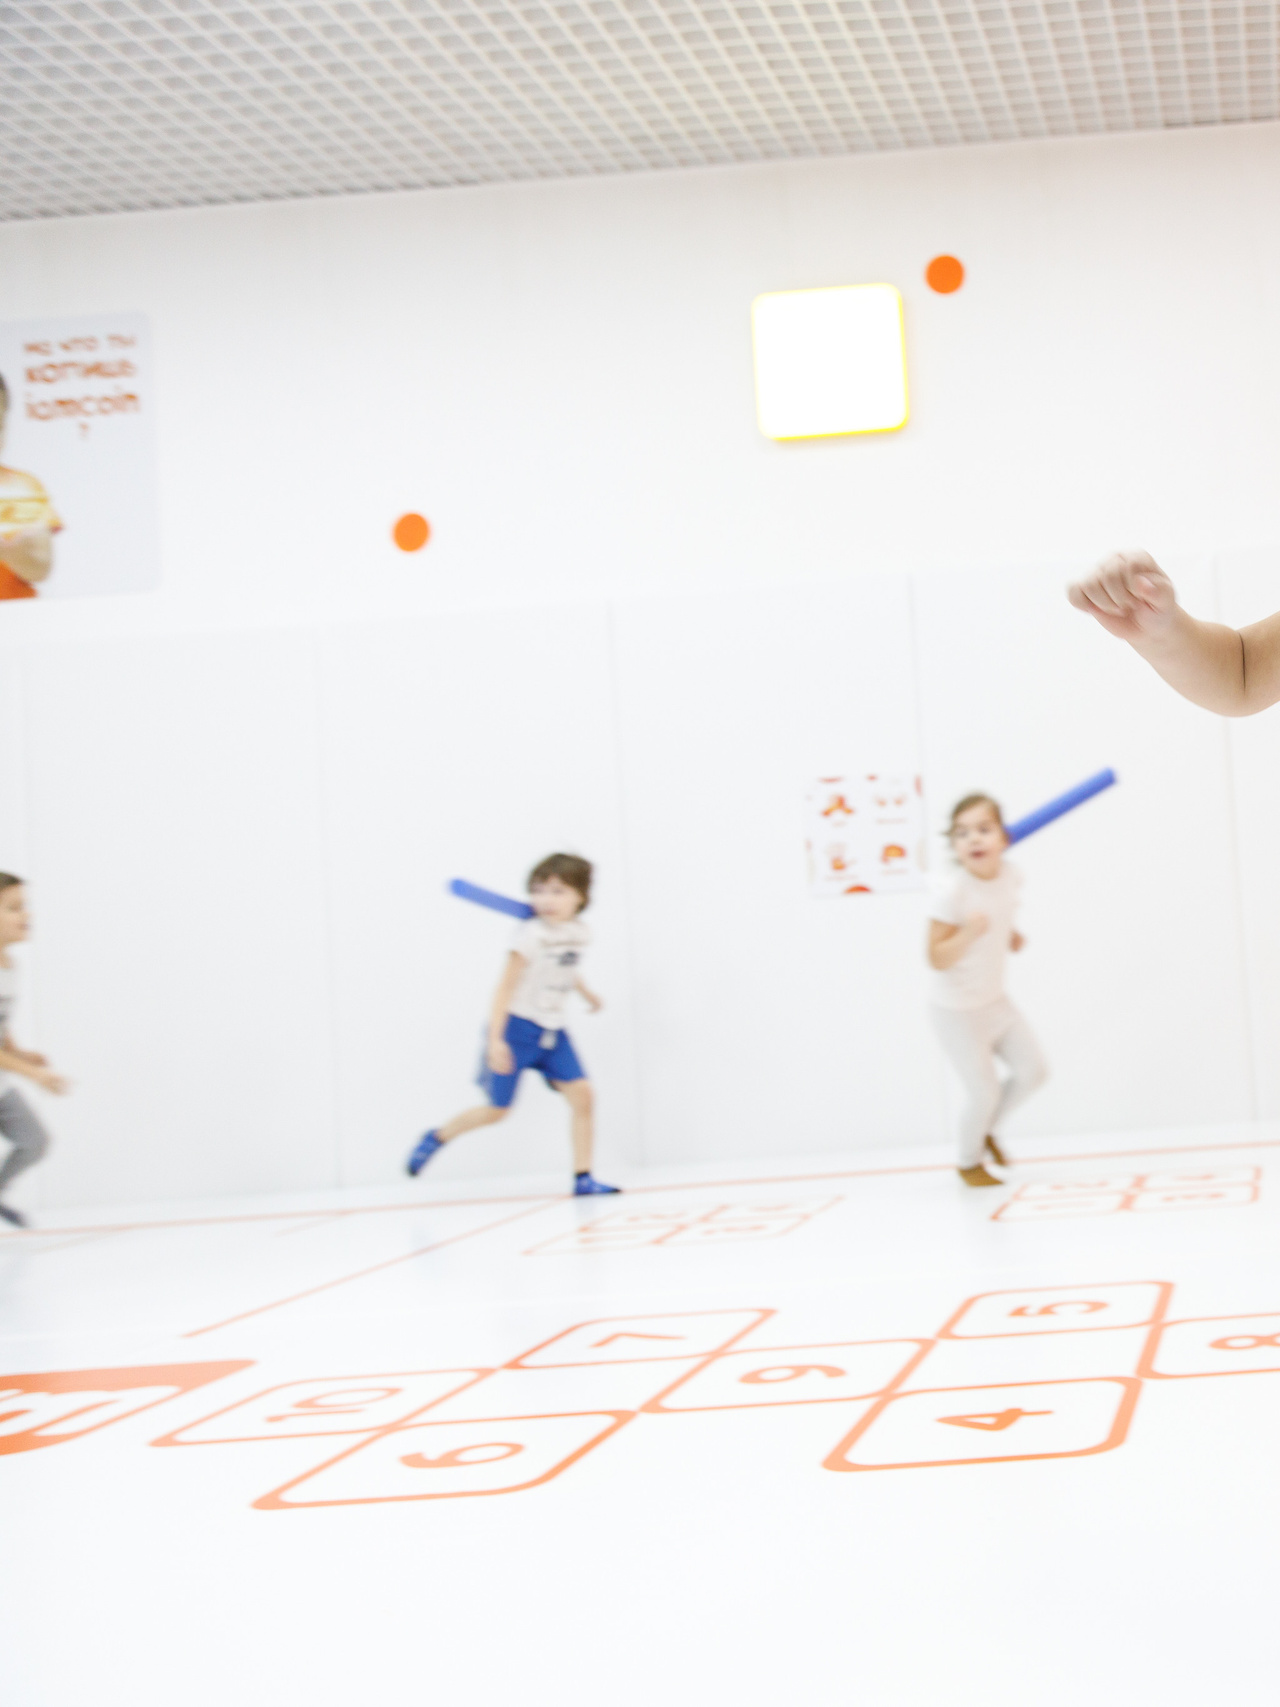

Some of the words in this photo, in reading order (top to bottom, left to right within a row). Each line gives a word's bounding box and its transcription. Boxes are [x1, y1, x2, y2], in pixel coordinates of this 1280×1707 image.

[1006, 1301, 1110, 1318] 5
[588, 1332, 688, 1348] 7
[264, 1387, 403, 1422] 10
[934, 1407, 1055, 1432] 4
